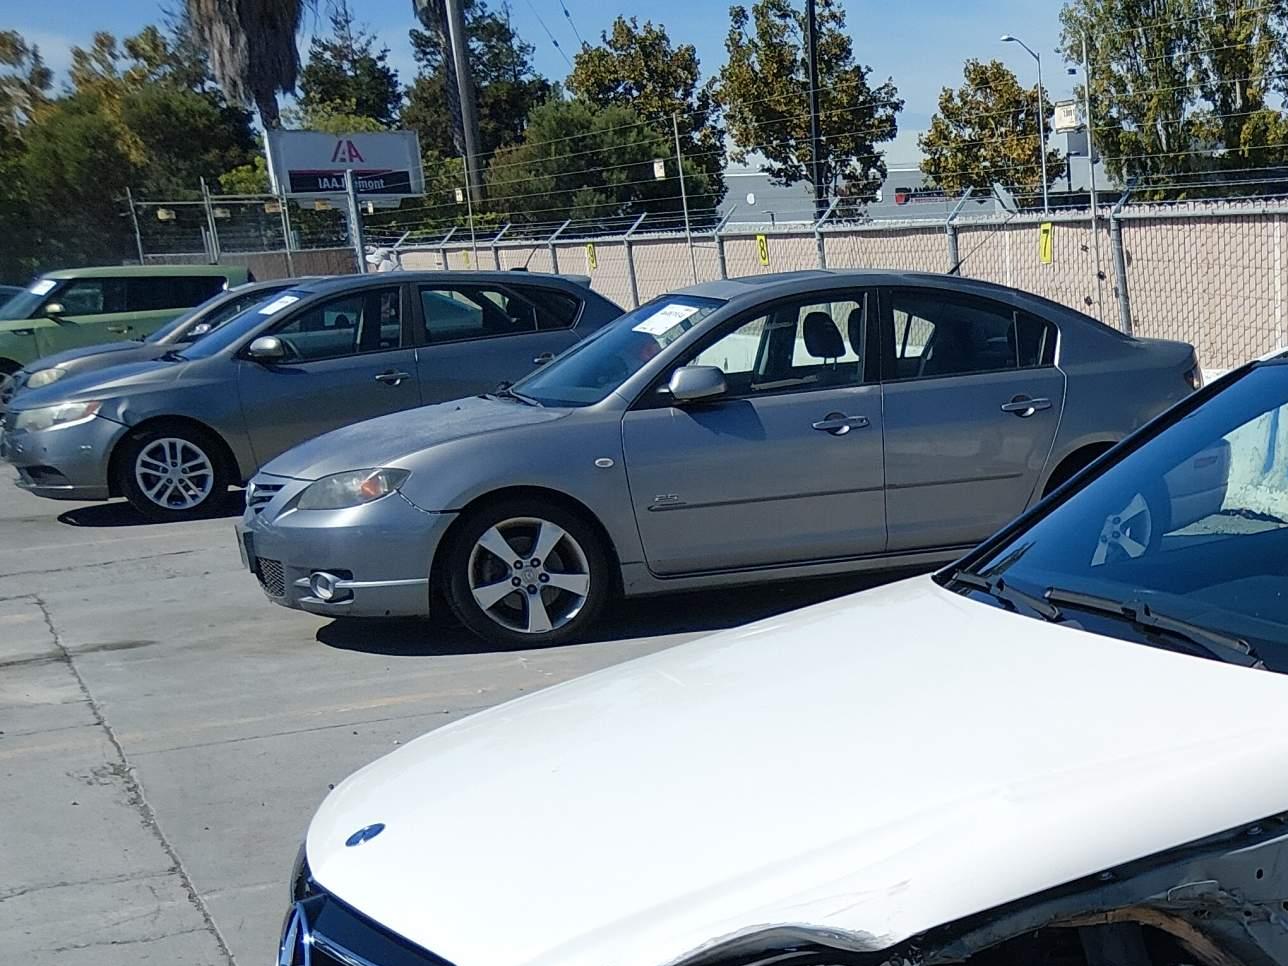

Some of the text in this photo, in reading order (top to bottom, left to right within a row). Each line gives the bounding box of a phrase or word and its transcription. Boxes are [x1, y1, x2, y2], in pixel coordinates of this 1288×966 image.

[318, 177, 340, 189] IAA
[759, 238, 767, 261] 8
[1042, 228, 1050, 257] 7
